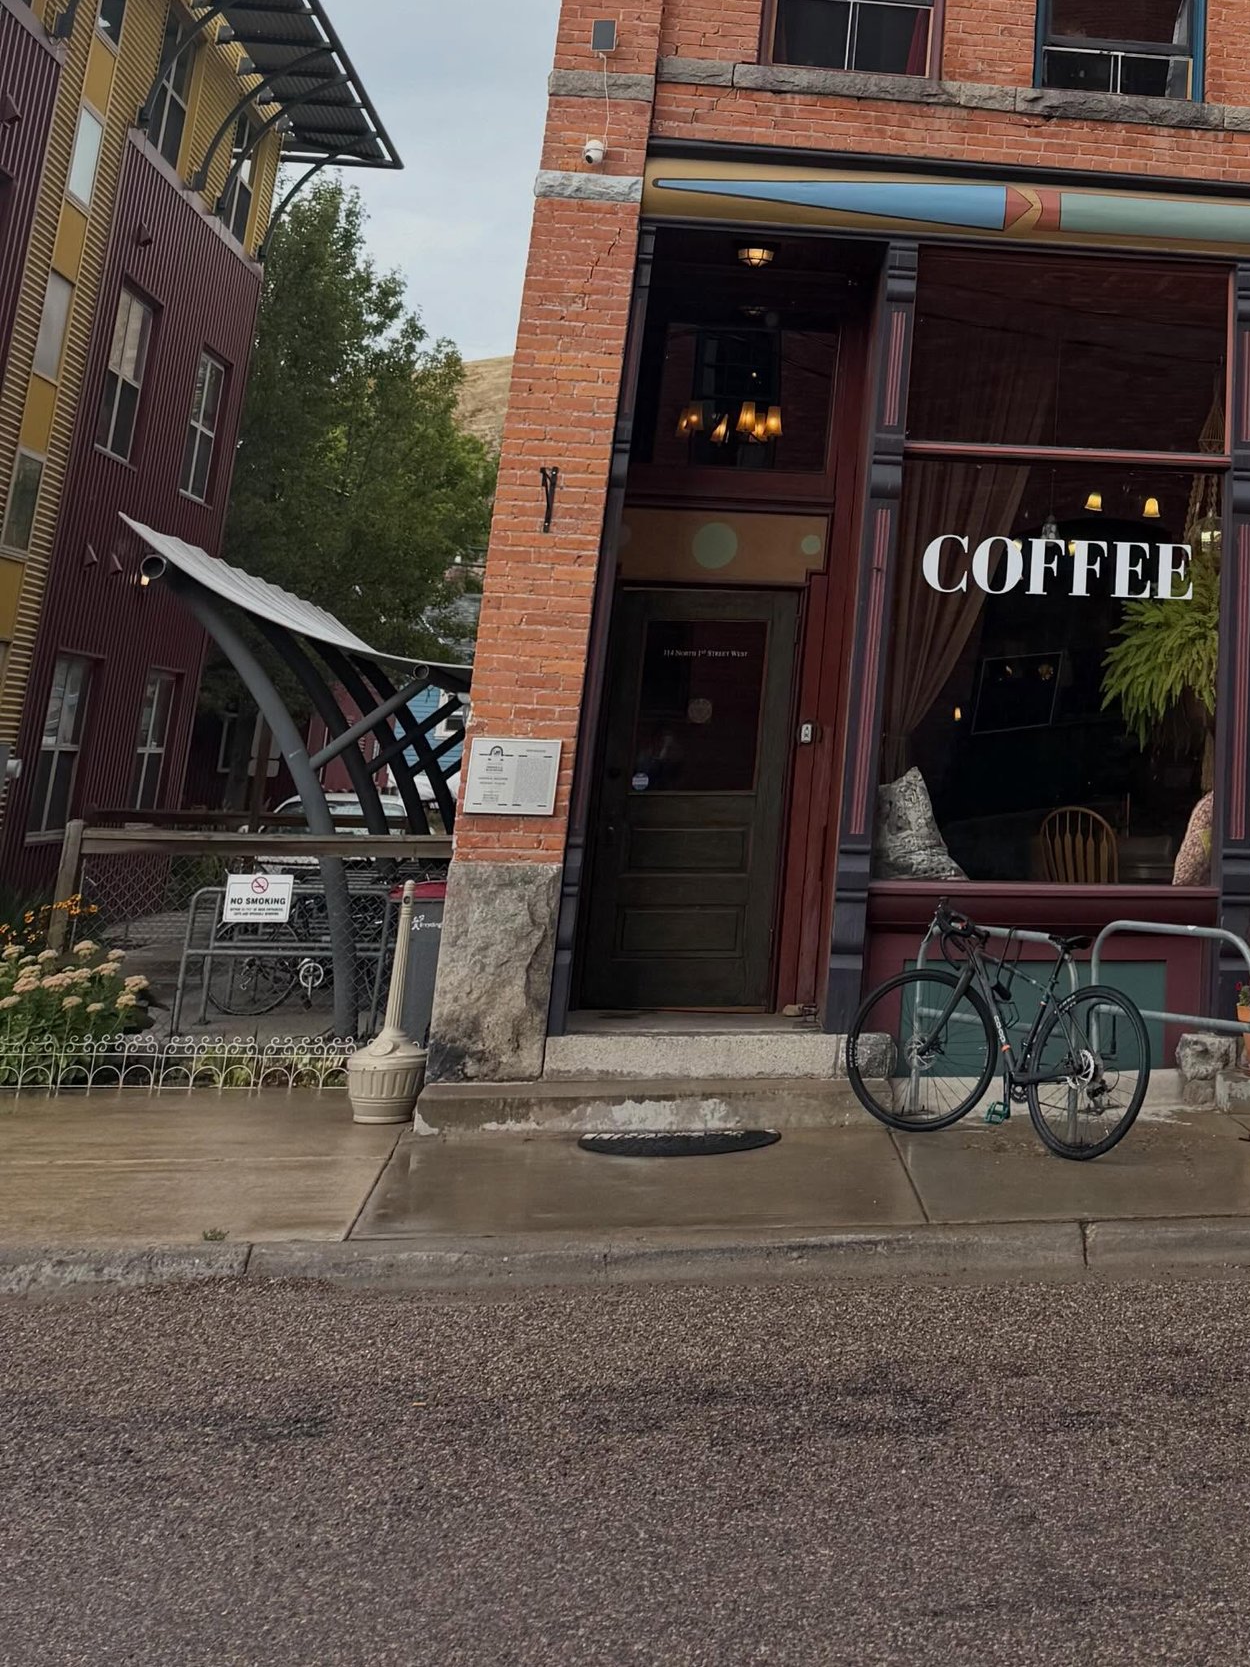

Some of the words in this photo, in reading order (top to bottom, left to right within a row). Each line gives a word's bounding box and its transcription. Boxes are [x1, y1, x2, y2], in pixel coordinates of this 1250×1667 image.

[922, 534, 1193, 600] COFFEE
[230, 897, 243, 905] NO
[245, 897, 286, 905] SMOKING
